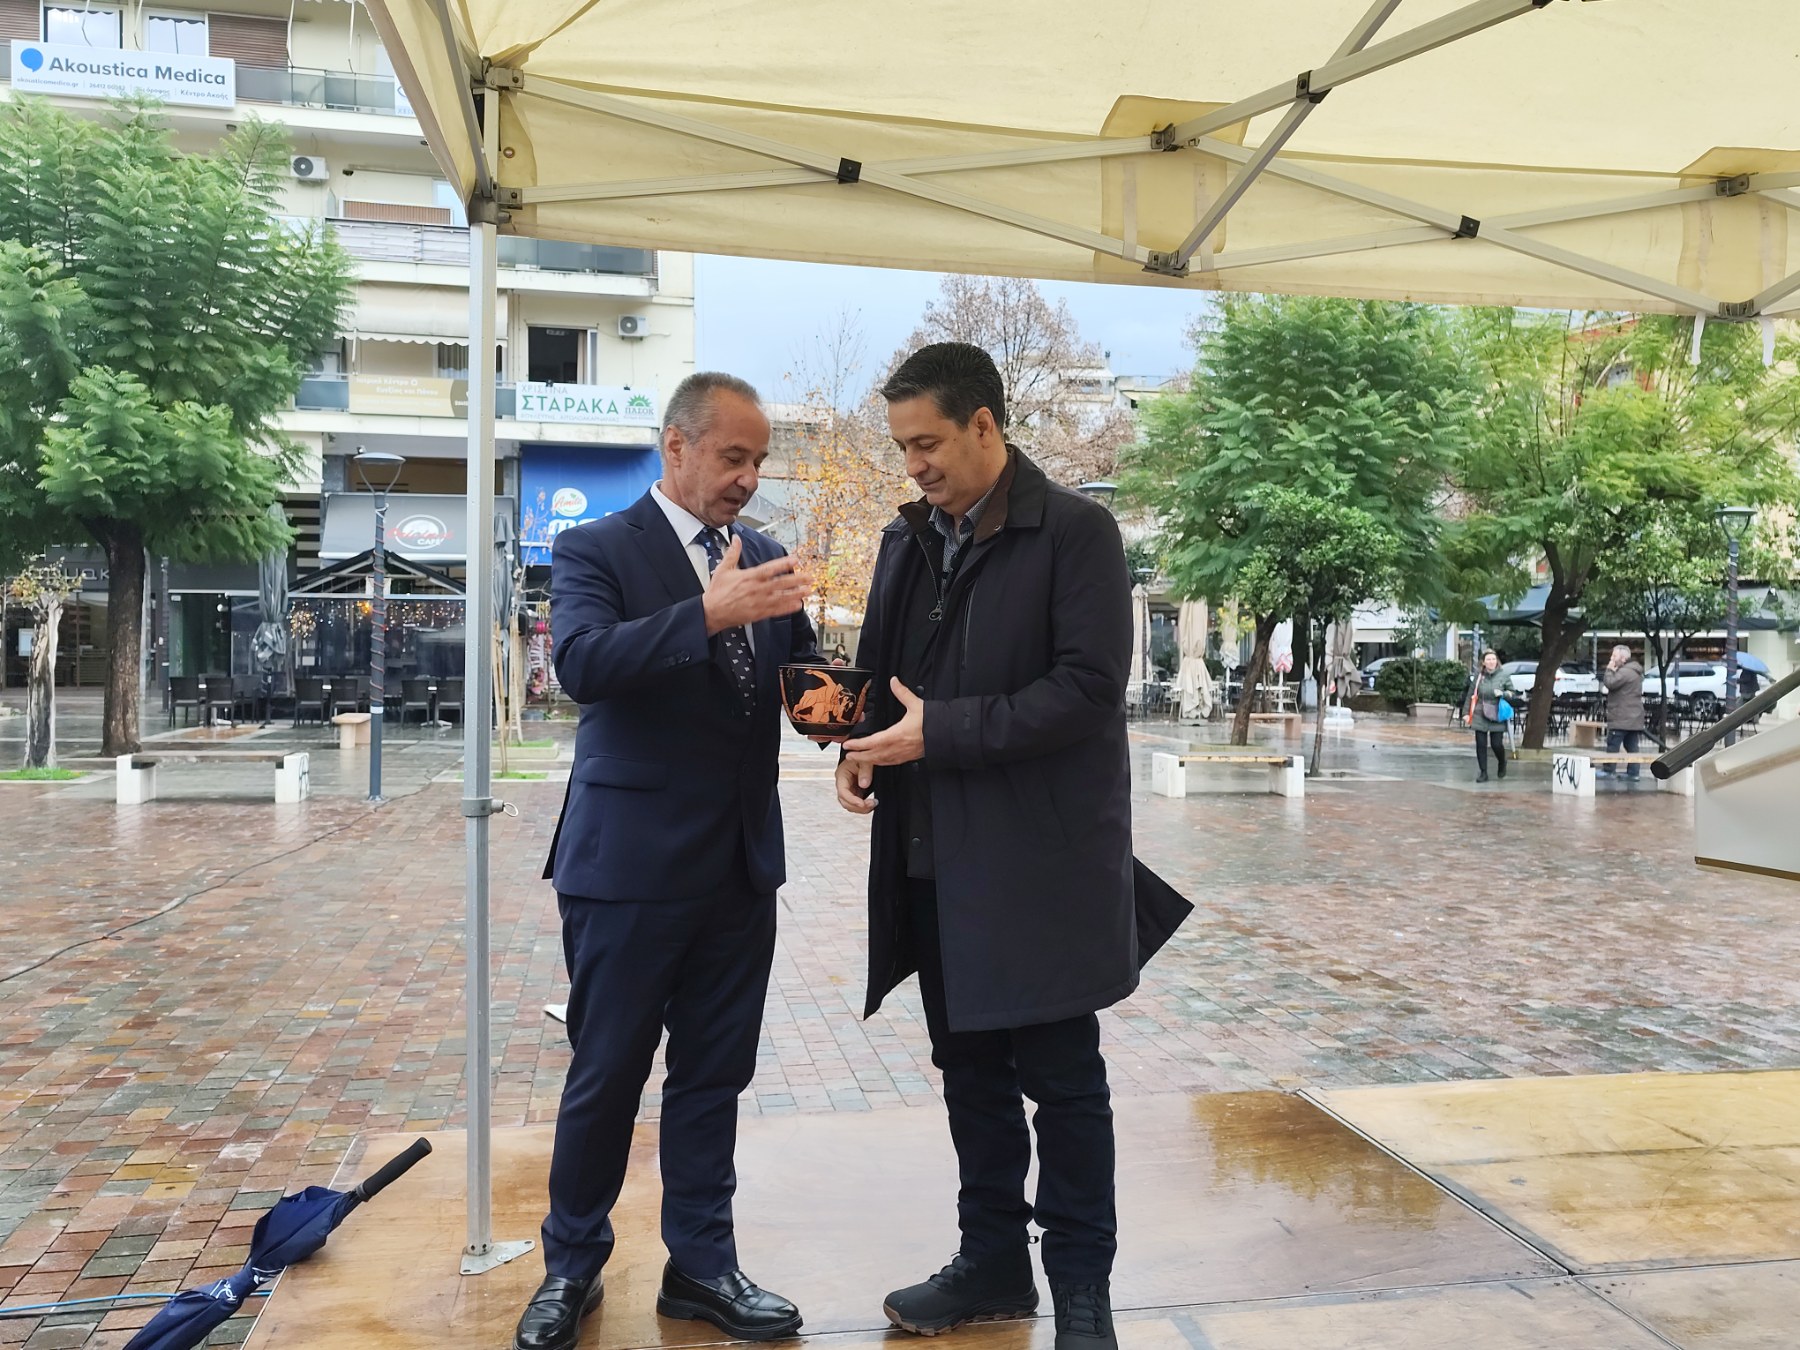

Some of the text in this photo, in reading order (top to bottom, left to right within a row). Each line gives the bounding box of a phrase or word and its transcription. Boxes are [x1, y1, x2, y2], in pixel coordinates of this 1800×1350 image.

[49, 57, 226, 85] Akoustica Medica
[522, 395, 619, 415] ΣΤΑΡΑΚΑ
